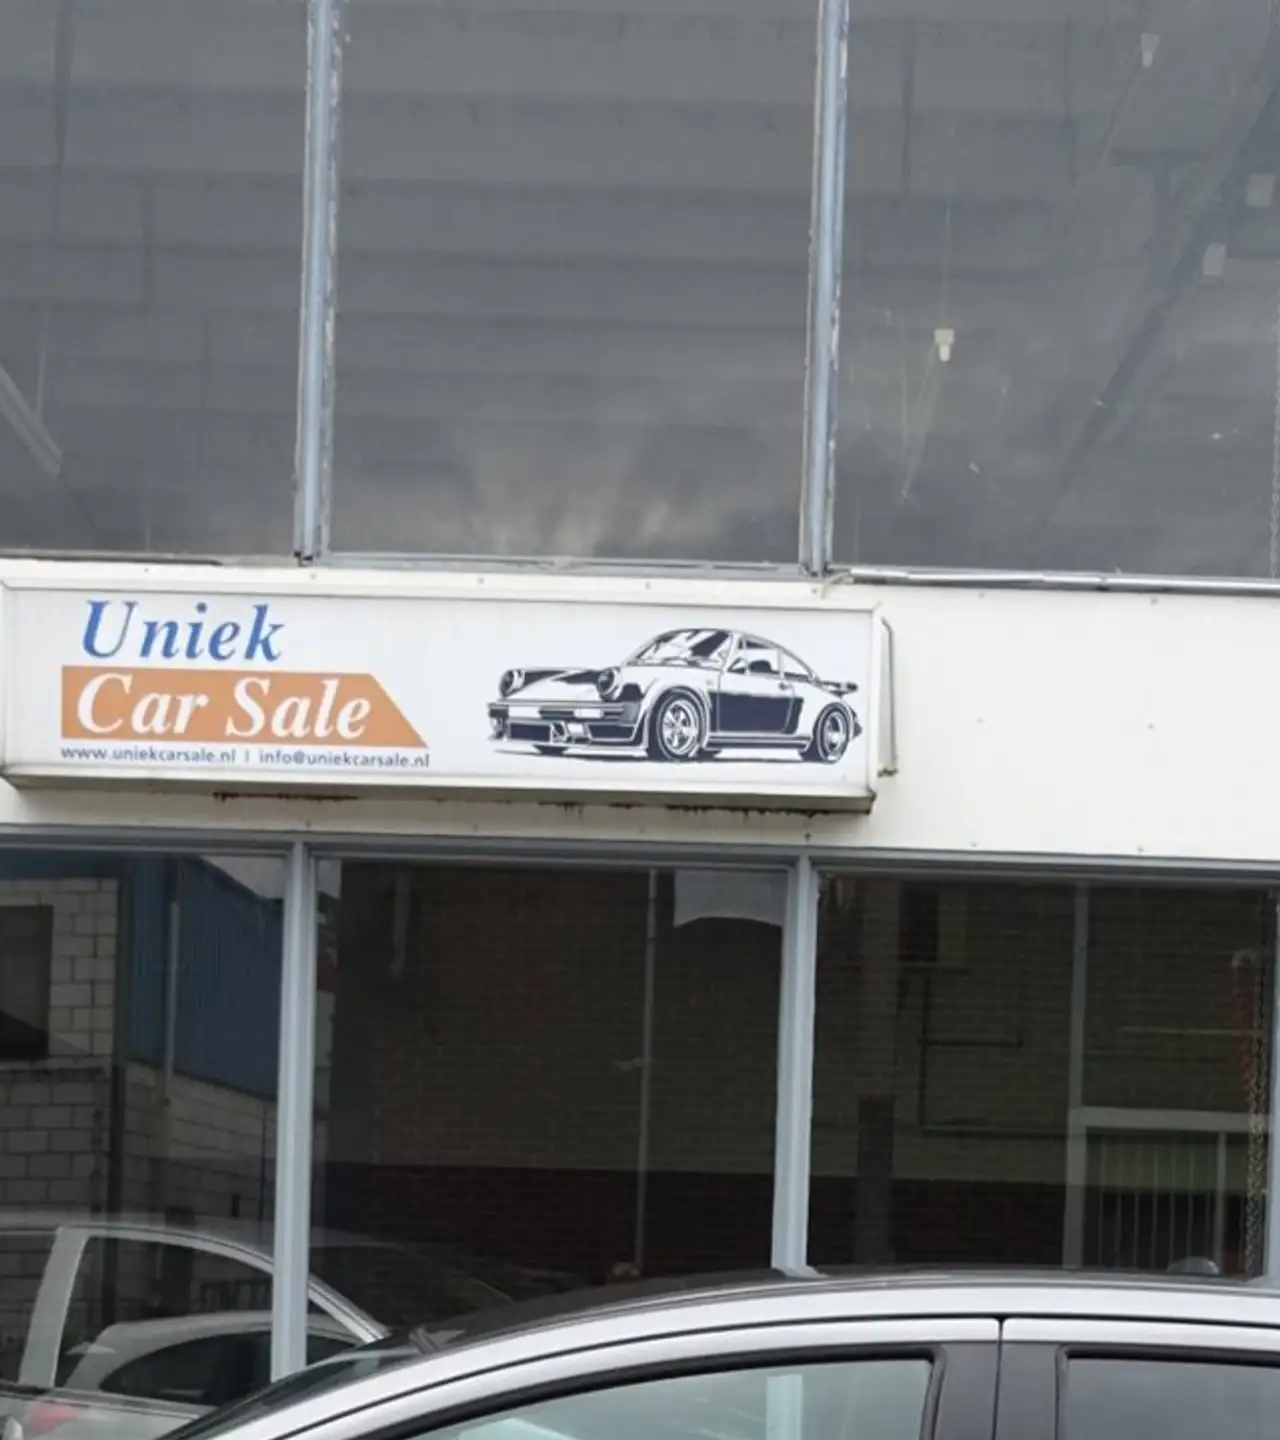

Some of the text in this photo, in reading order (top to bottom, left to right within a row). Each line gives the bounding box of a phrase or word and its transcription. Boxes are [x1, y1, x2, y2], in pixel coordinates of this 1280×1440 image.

[82, 599, 285, 662] Uniek
[77, 672, 372, 740] Car Sale
[60, 744, 430, 769] www.uniekcarsale.nl info@uniekcarsale.nl
